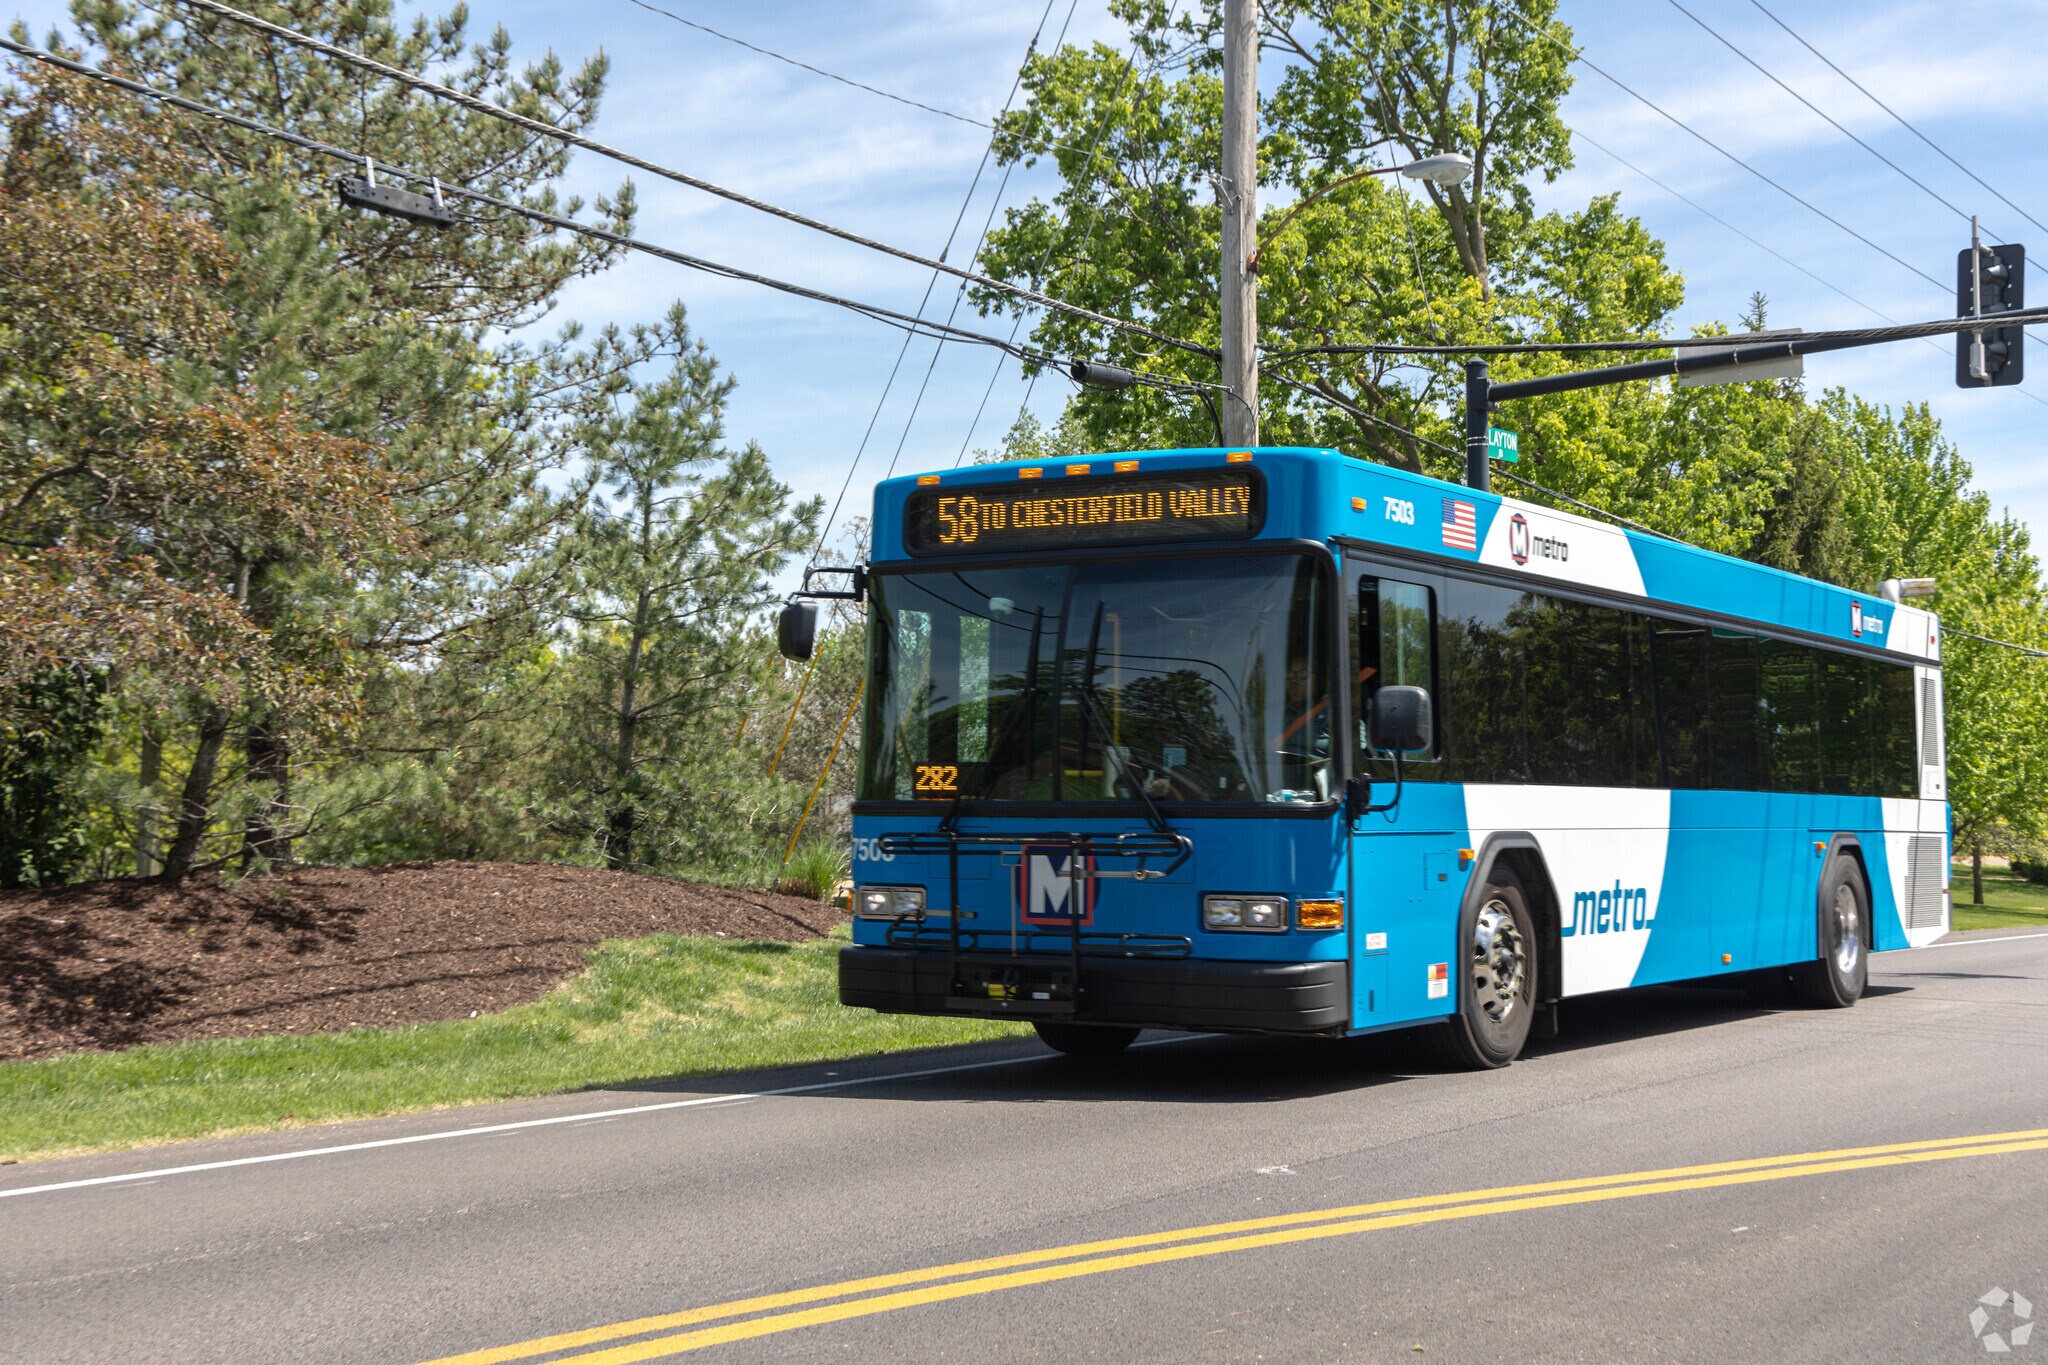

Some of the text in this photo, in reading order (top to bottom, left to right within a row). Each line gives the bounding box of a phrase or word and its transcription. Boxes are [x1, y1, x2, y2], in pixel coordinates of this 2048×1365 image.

[1488, 428, 1517, 451] LAYTON
[938, 486, 1251, 543] 58 TO CHESTERFIELD VALLEY
[1383, 496, 1415, 525] 7503
[1532, 535, 1568, 562] metro
[916, 765, 958, 791] 282
[1029, 854, 1085, 915] M
[1562, 878, 1648, 937] metro
